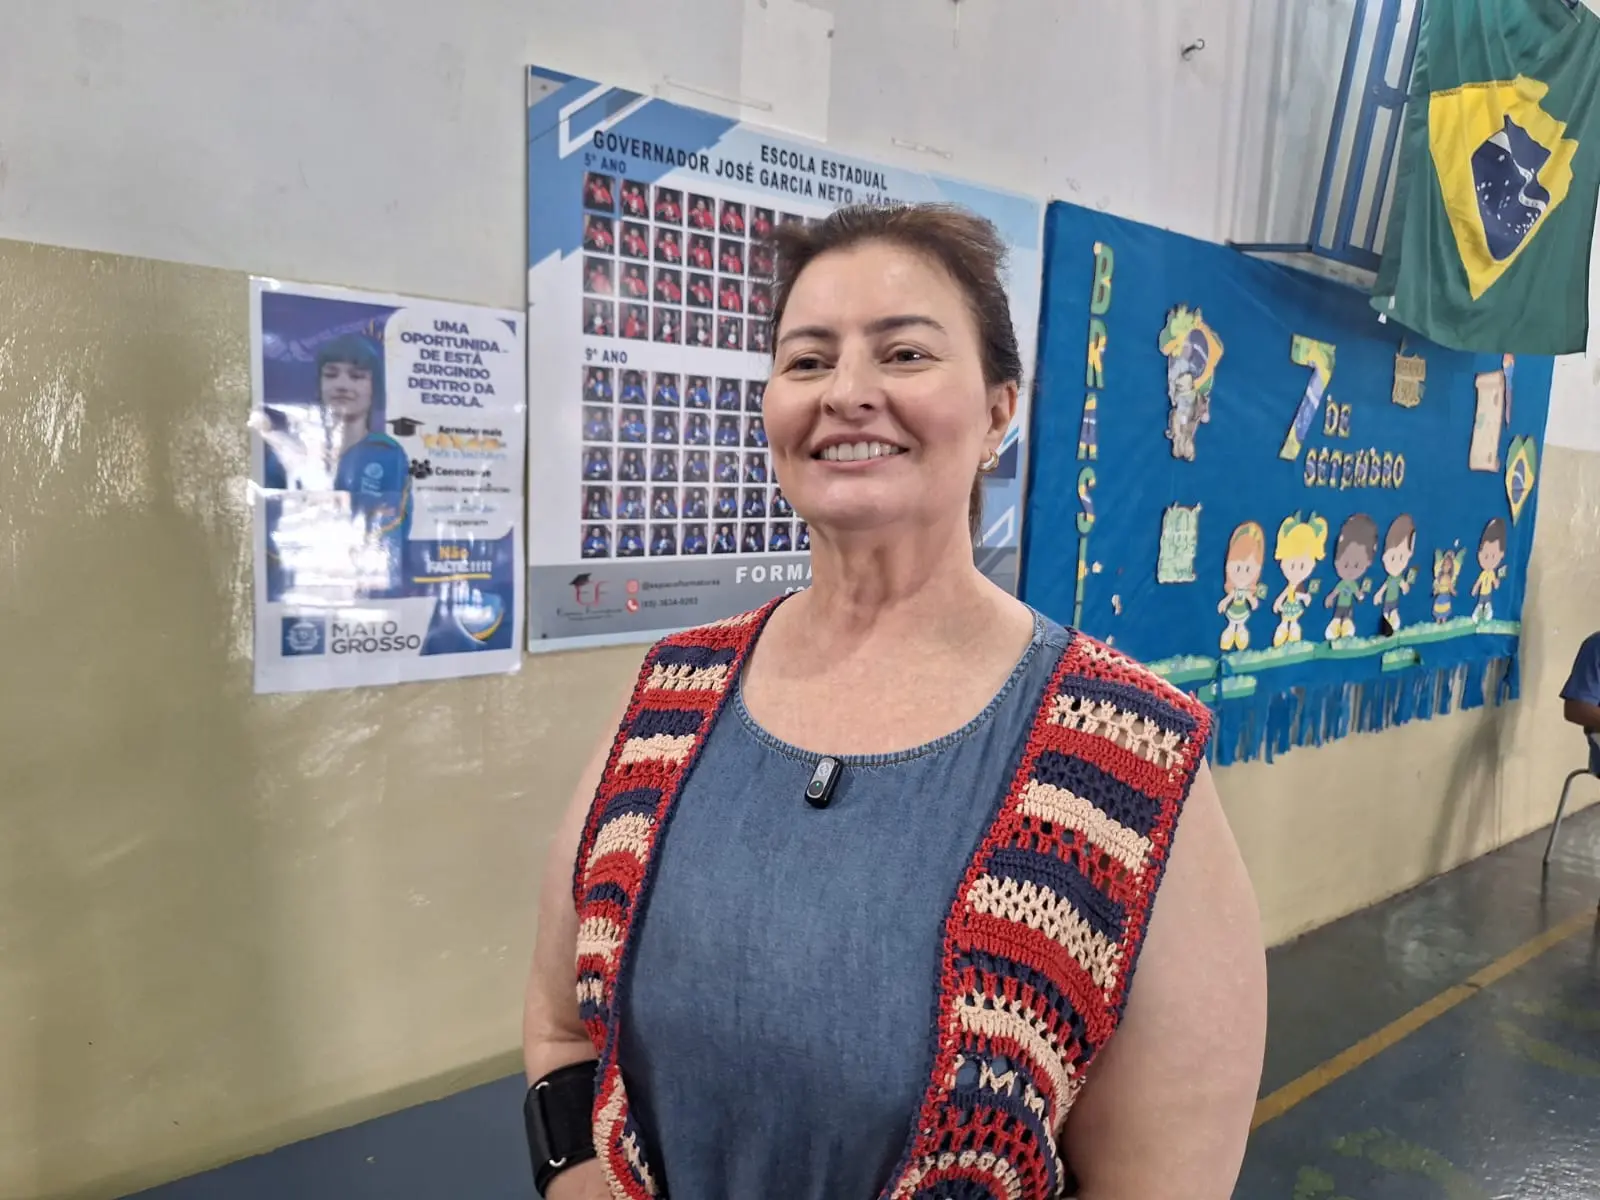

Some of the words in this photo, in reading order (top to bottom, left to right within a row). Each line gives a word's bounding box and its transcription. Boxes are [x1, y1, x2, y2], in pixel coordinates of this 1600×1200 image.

[593, 130, 709, 174] GOVERNADOR
[715, 159, 754, 184] JOSÉ
[760, 168, 812, 197] GARCIA
[818, 181, 853, 204] NETO
[601, 156, 627, 175] ANO
[761, 144, 815, 175] ESCOLA
[821, 159, 887, 191] ESTADUAL
[434, 319, 469, 335] UMA
[420, 348, 441, 362] DE
[445, 350, 483, 366] ESTÁ
[602, 349, 628, 364] ANO
[412, 362, 490, 380] SURGINDO
[408, 376, 471, 393] DENTRO
[474, 382, 495, 396] DA
[421, 392, 484, 408] ESCOLA.
[1278, 333, 1337, 461] 7
[1323, 402, 1352, 438] DE
[1303, 448, 1405, 488] SETEMBRO
[332, 620, 398, 638] MATO
[331, 634, 421, 654] GROSSO
